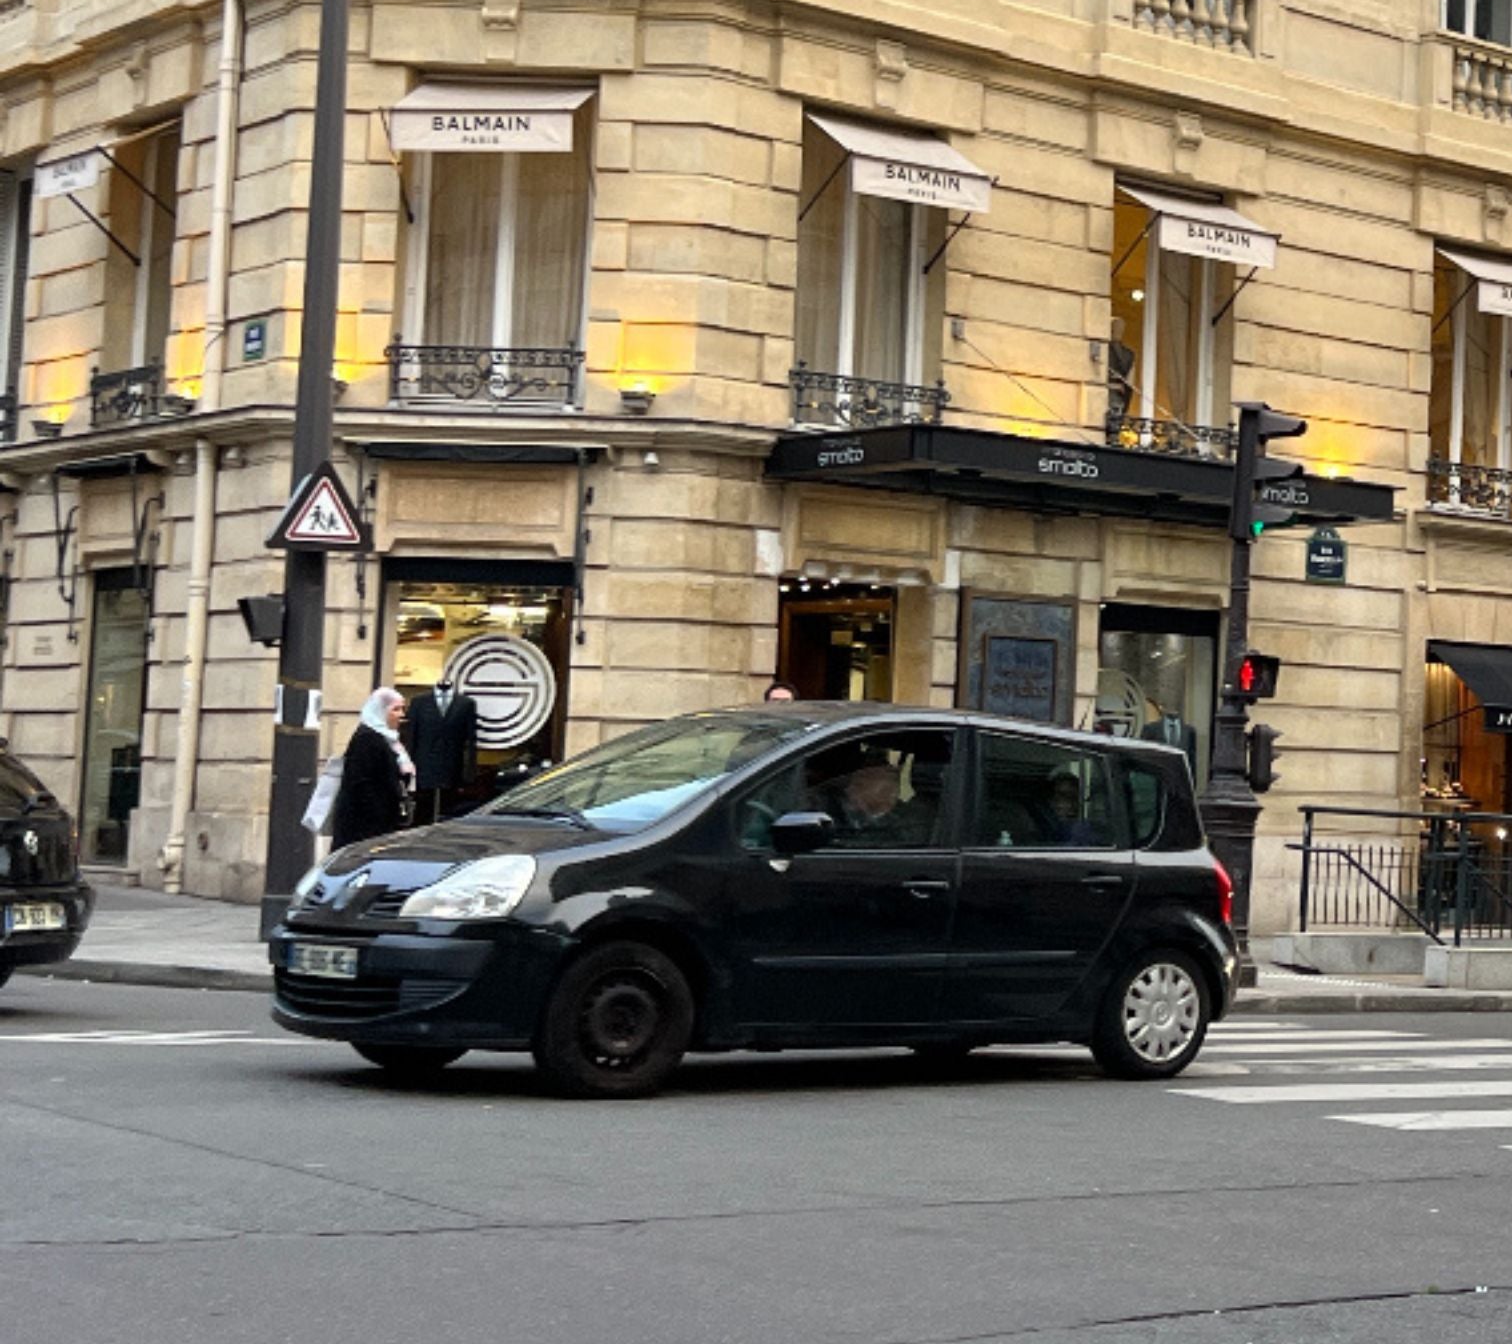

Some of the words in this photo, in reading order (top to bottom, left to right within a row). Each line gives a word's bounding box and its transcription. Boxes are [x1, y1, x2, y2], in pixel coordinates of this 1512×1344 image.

[431, 116, 531, 131] BALMAIN
[461, 135, 500, 145] PARIS
[884, 163, 961, 192] BALMAIN
[1187, 223, 1251, 248] BALMAIN
[1261, 486, 1310, 505] malto
